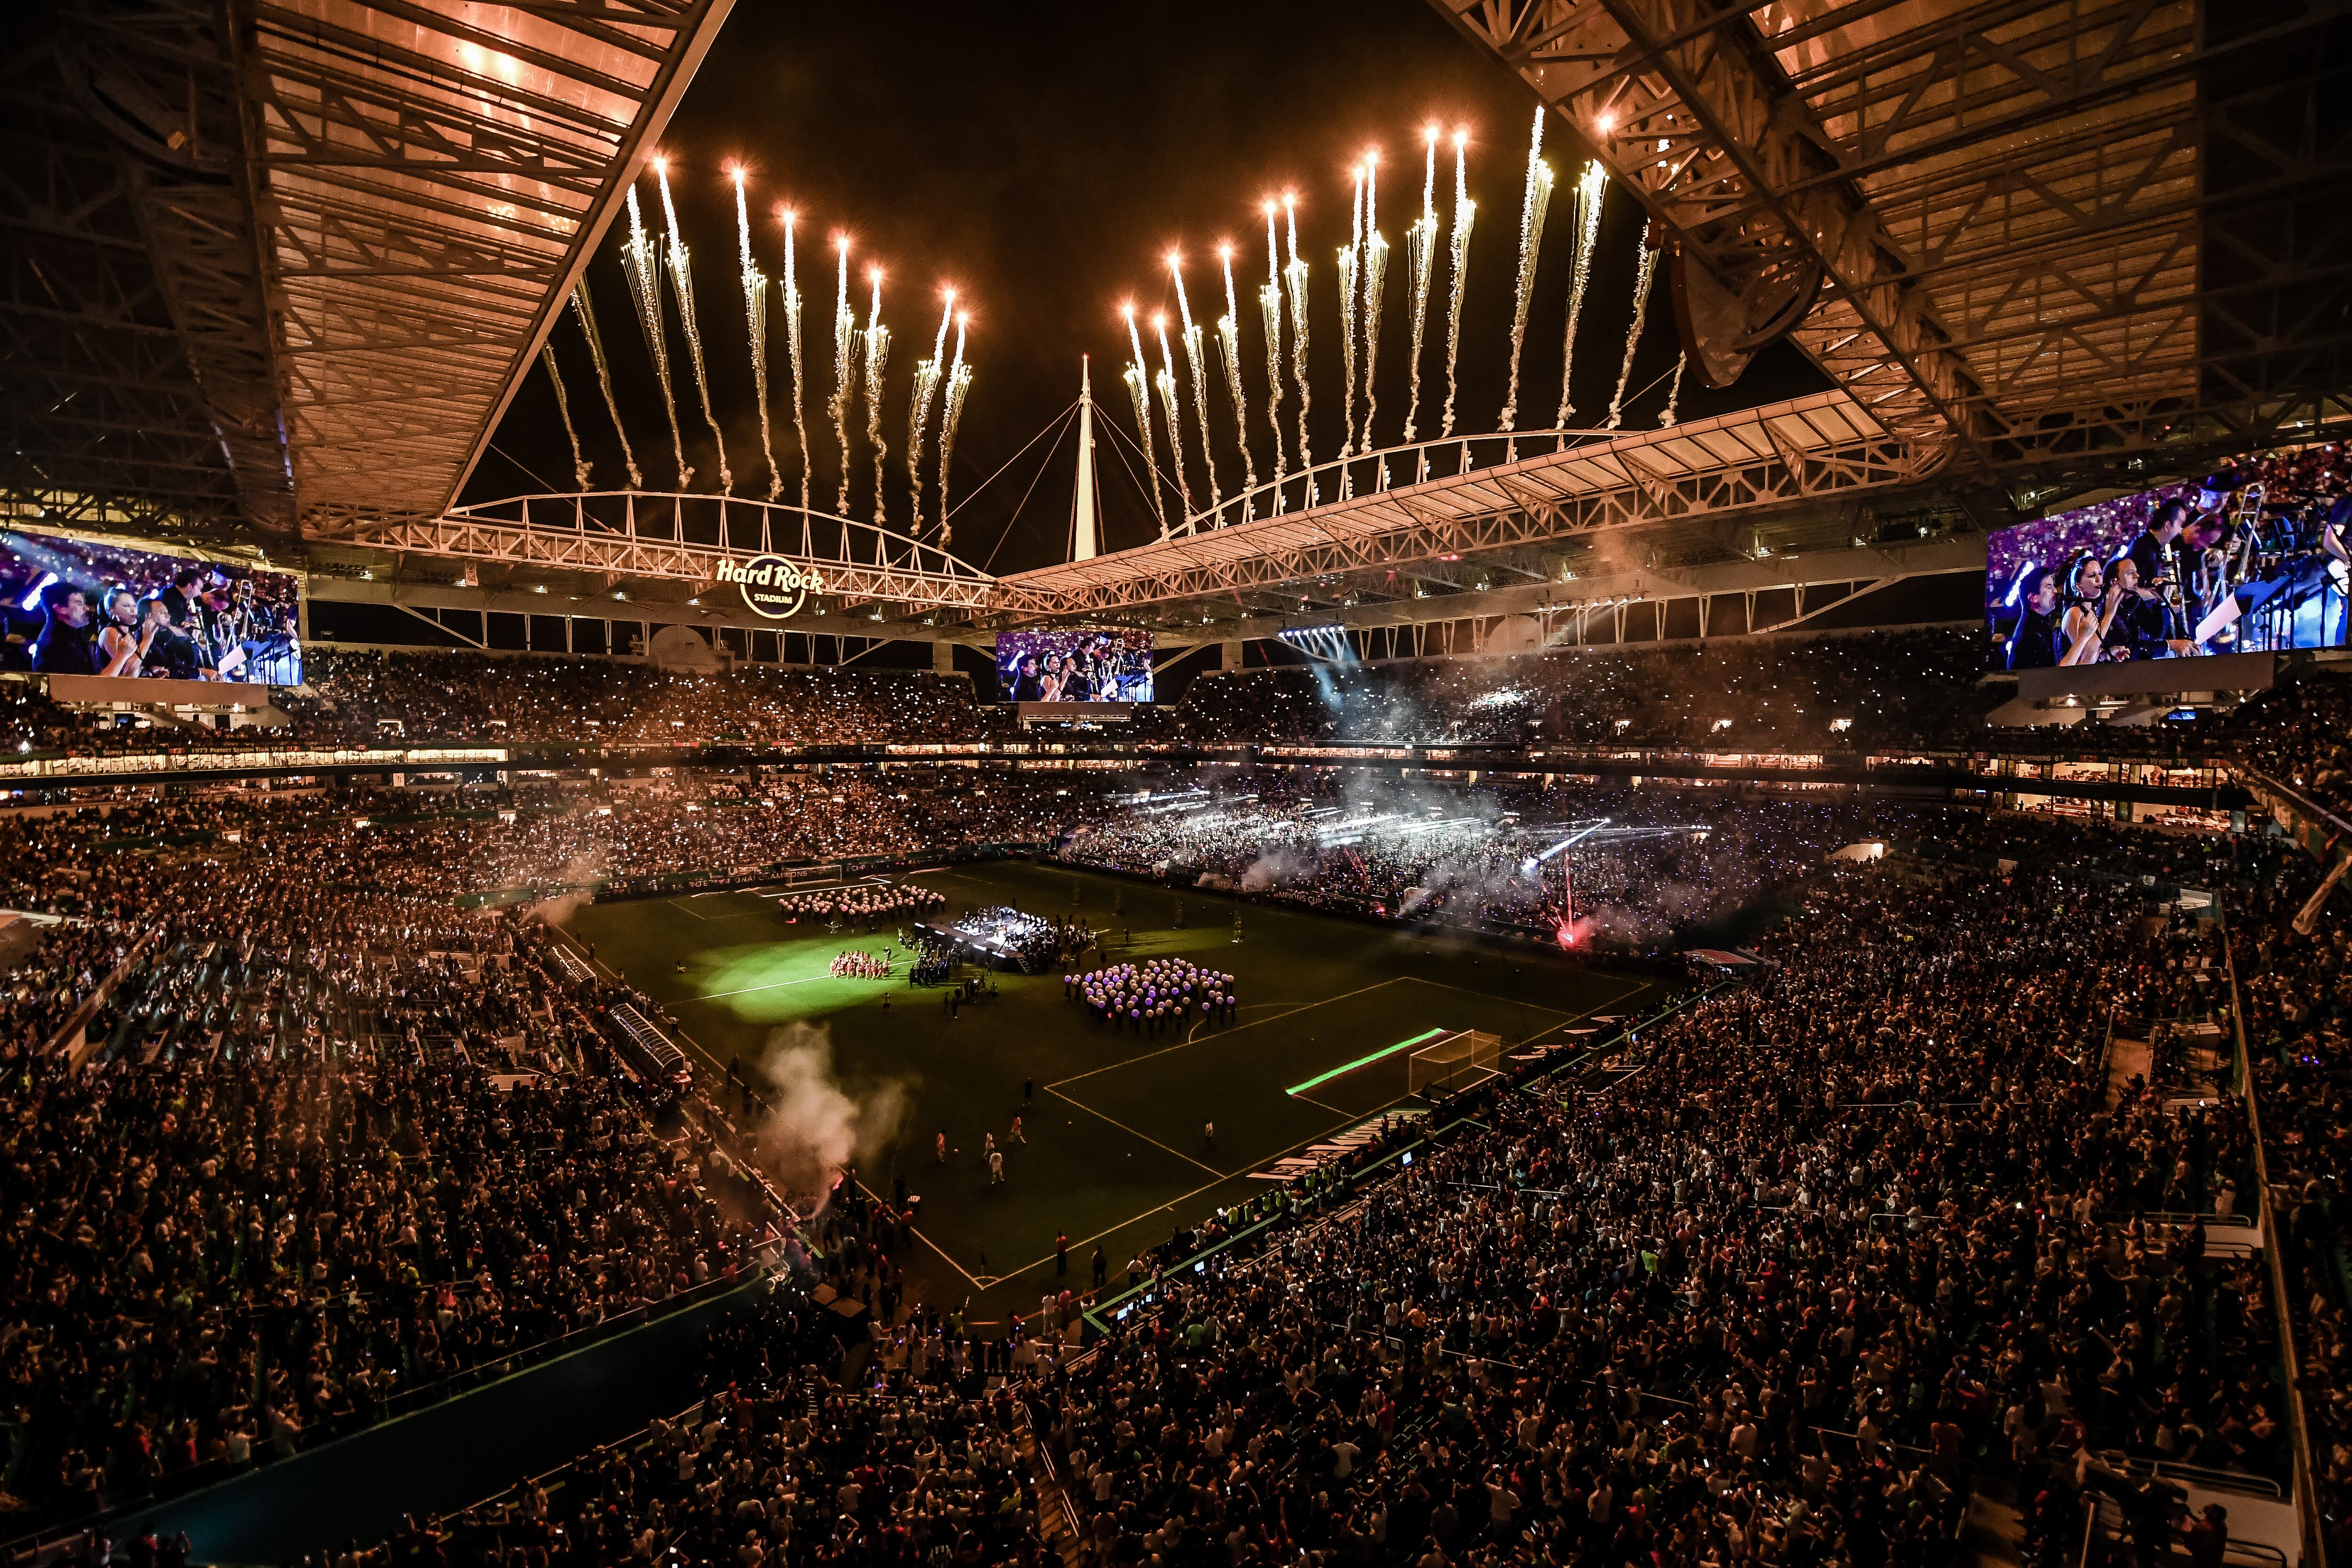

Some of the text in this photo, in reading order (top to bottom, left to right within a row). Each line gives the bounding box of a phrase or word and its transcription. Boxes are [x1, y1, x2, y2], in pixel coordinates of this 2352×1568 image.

[716, 559, 824, 595] Hard Rock
[754, 594, 793, 604] STADIUM
